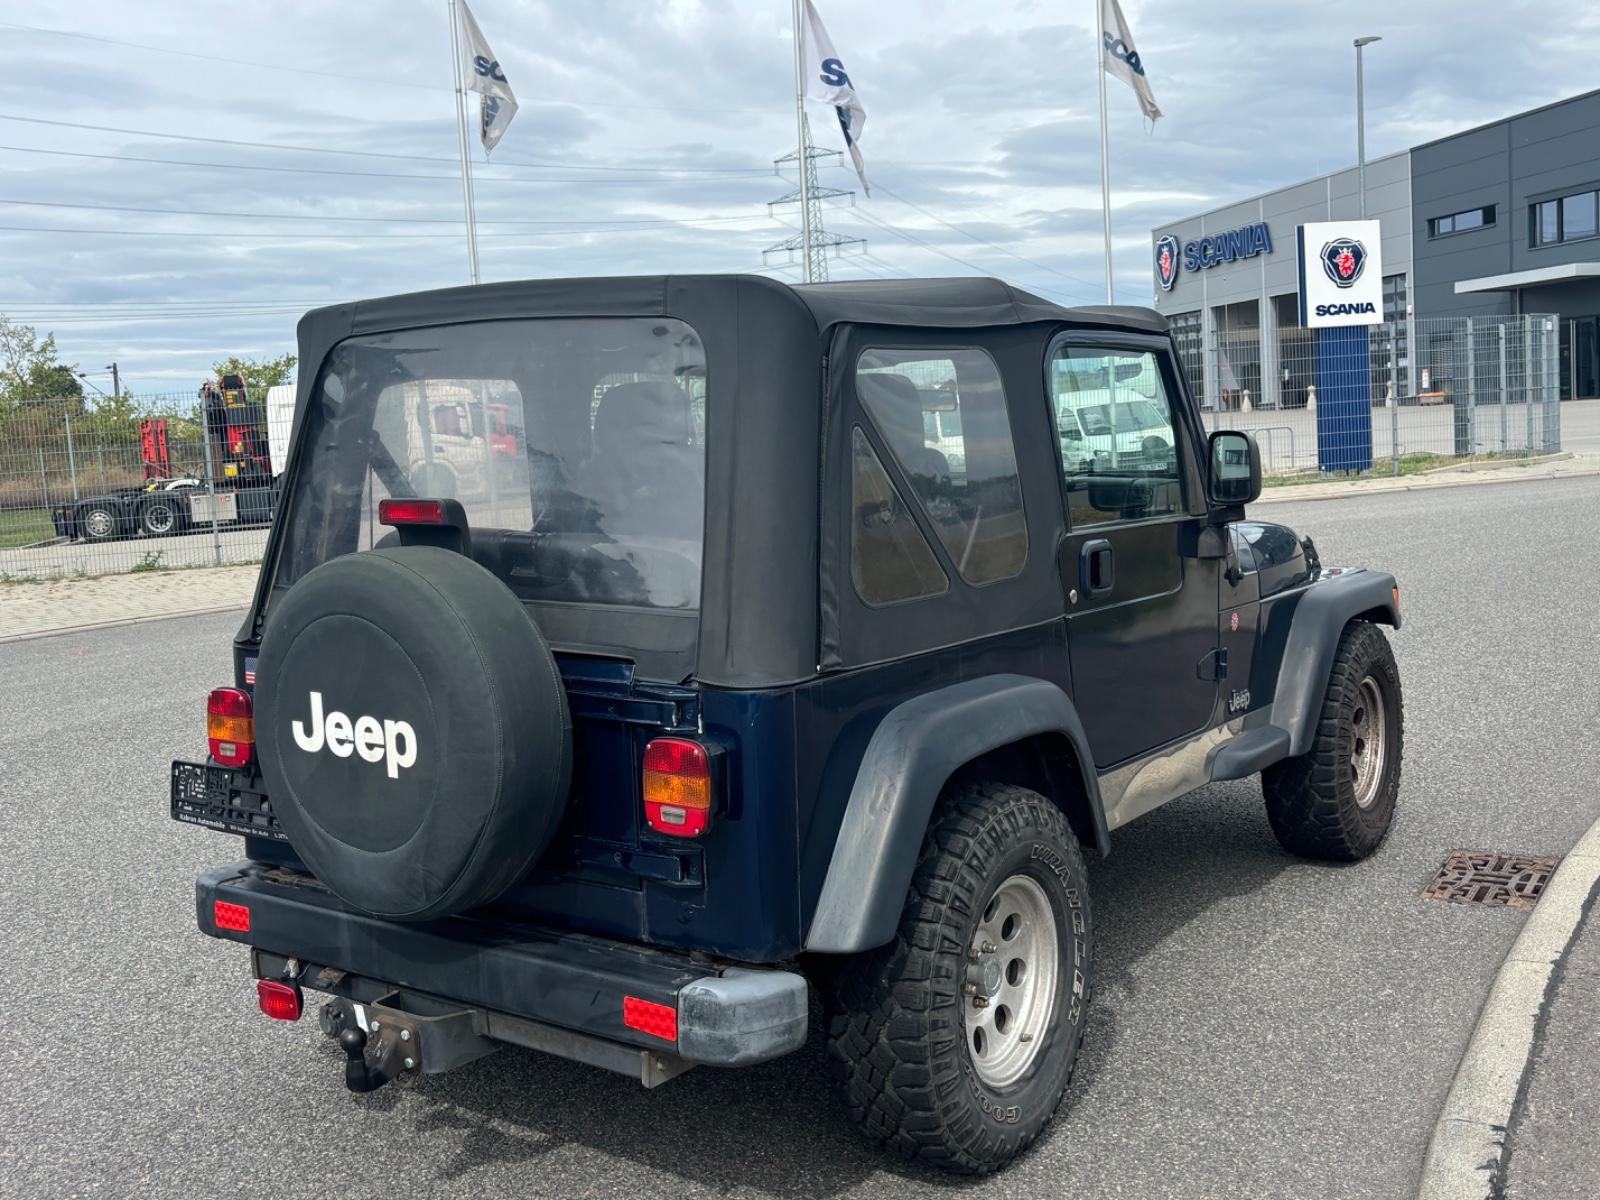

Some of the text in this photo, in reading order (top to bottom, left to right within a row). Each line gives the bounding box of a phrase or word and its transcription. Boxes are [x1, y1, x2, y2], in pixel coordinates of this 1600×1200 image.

[1103, 30, 1145, 76] SCA
[1184, 222, 1273, 273] SCANIA
[1315, 302, 1376, 317] SCANIA
[1229, 689, 1250, 713] Jeep
[291, 691, 418, 779] Jeep
[1030, 844, 1086, 1027] WRANGLER
